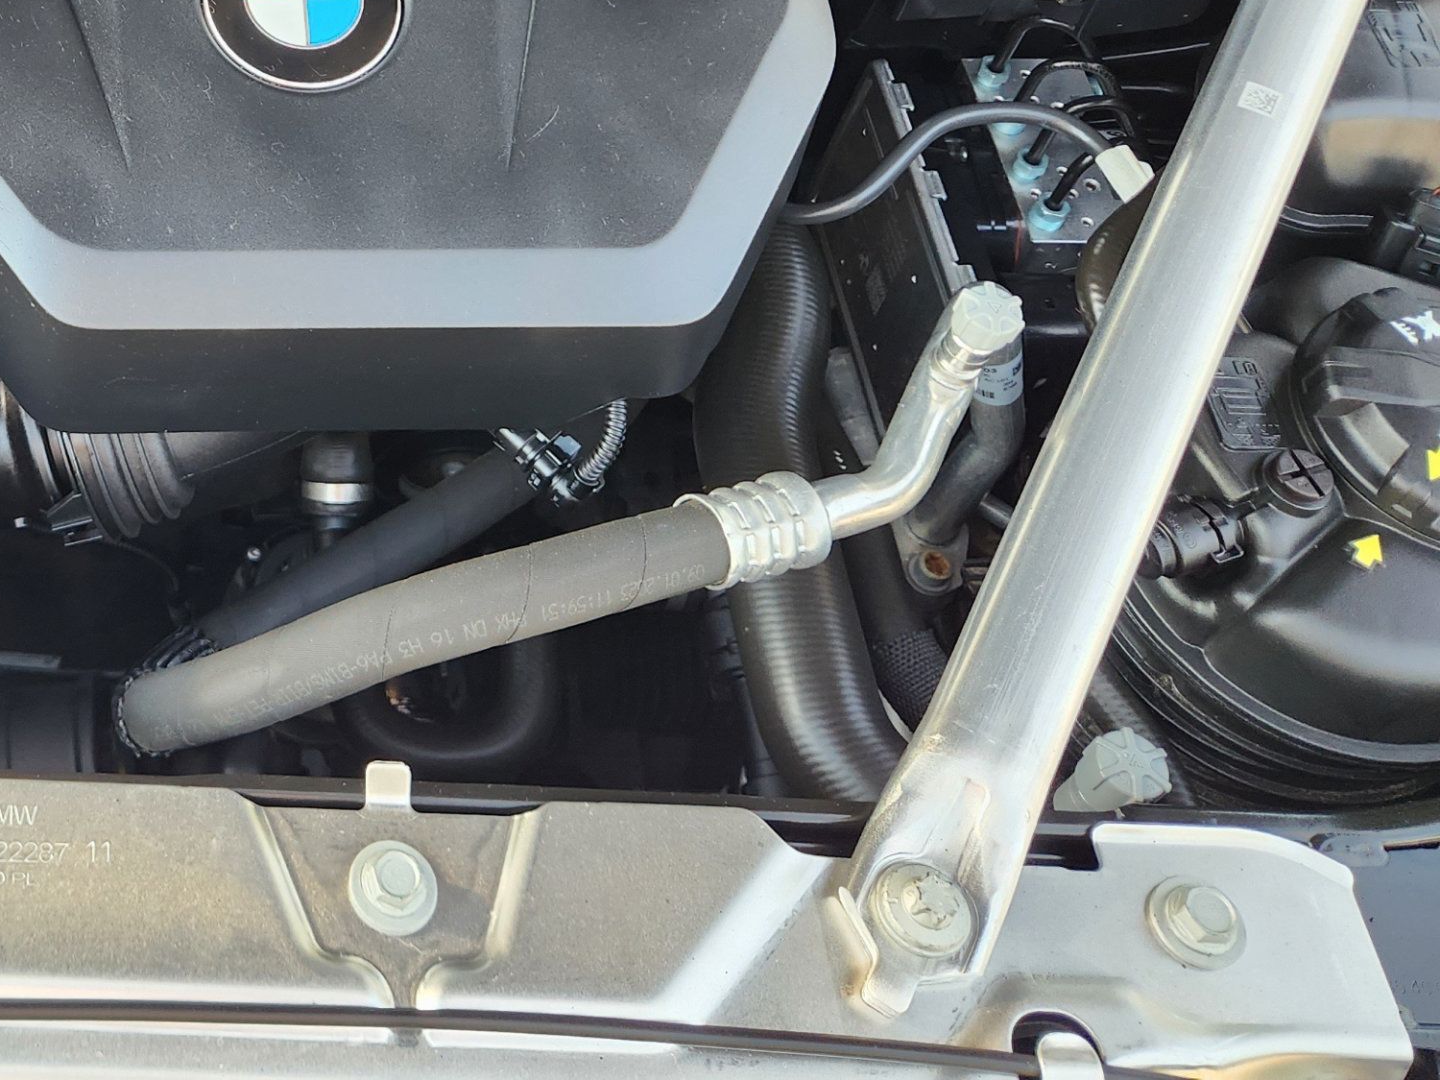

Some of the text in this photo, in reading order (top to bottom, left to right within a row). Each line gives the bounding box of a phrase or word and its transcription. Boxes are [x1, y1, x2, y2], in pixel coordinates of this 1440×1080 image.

[541, 589, 611, 622] 11:59:51
[430, 628, 454, 648] 16
[462, 619, 488, 642] DN
[398, 637, 425, 658] H3
[86, 840, 113, 863] 11
